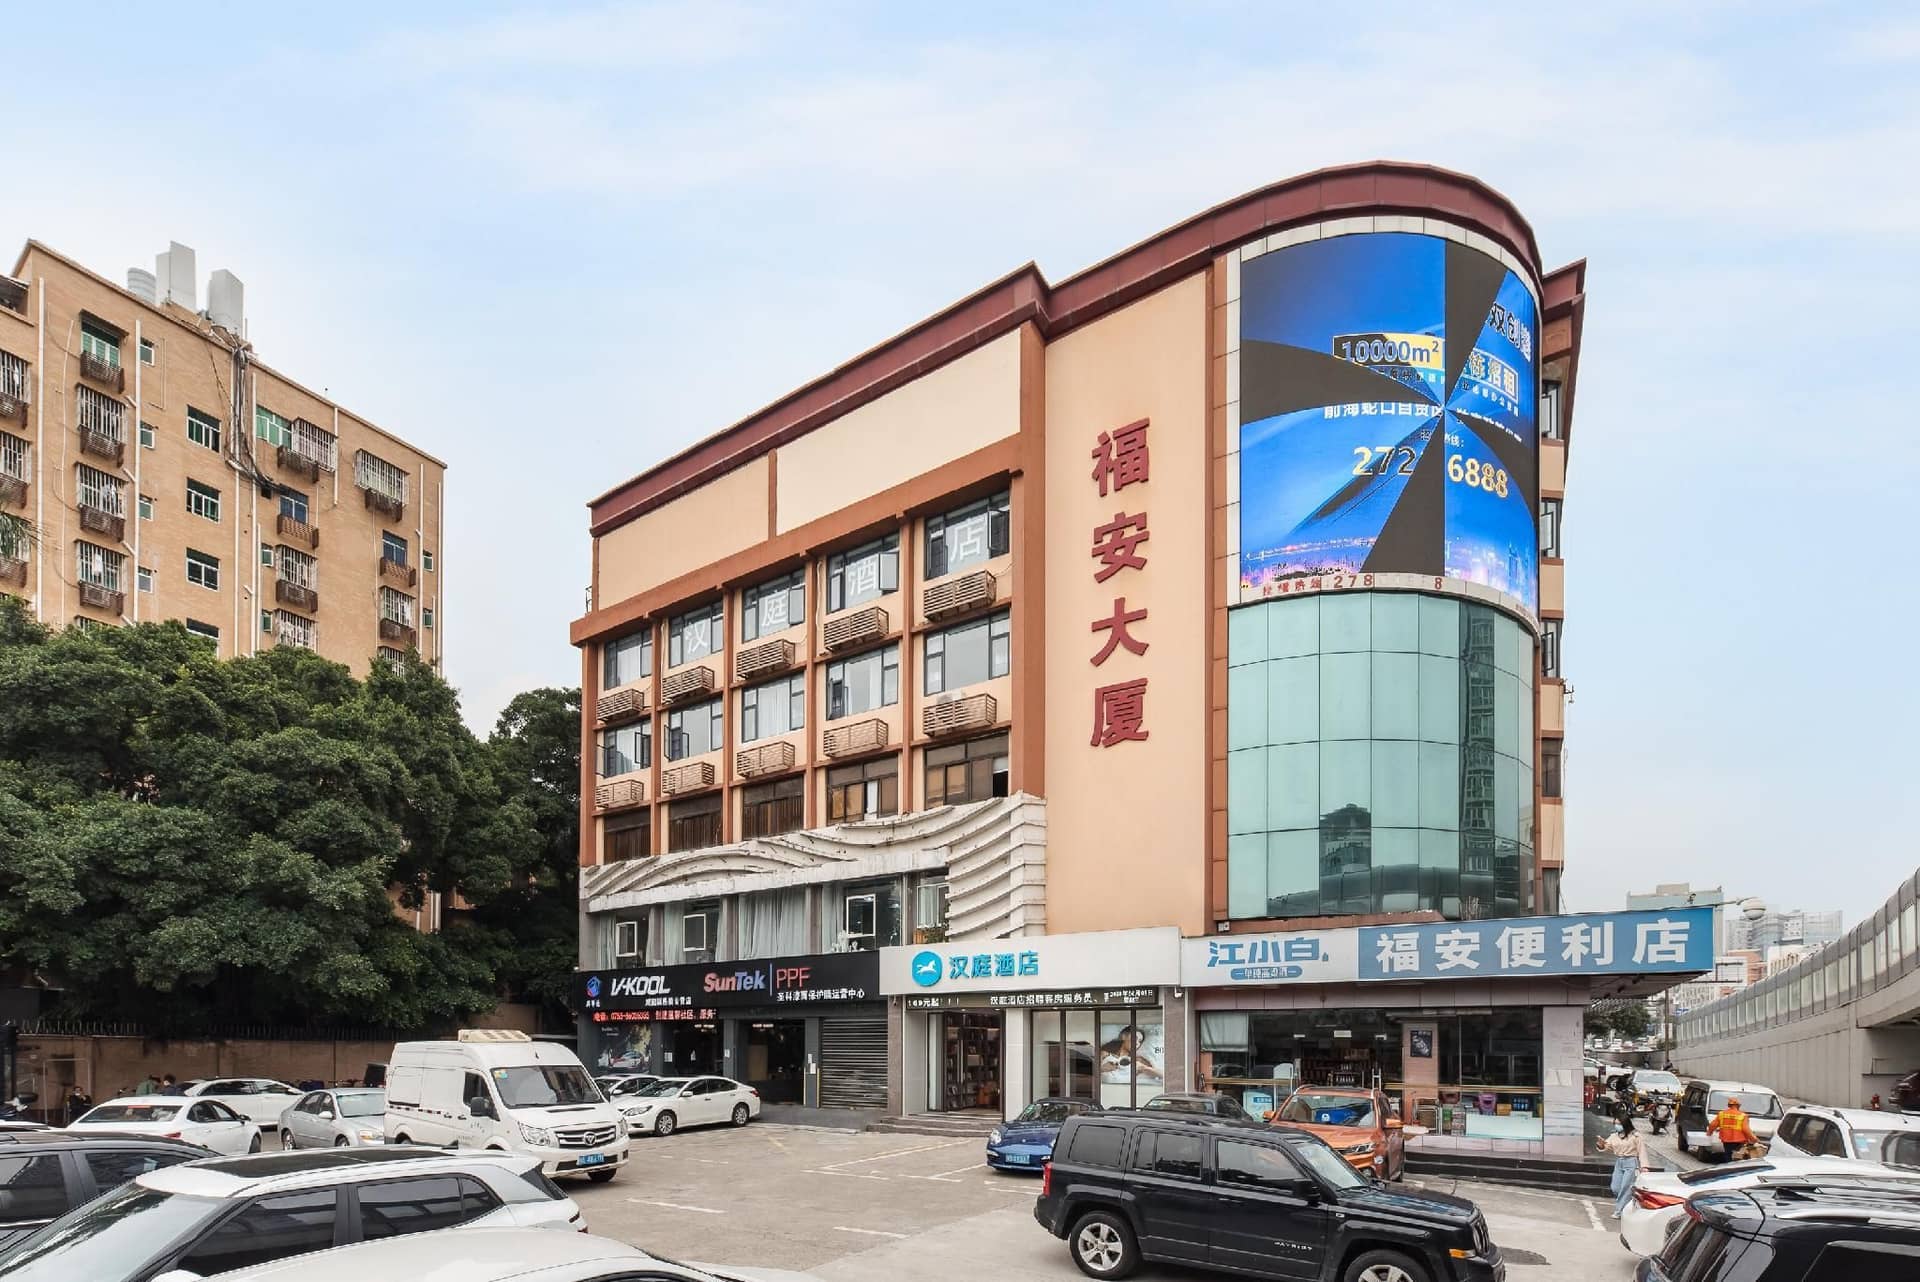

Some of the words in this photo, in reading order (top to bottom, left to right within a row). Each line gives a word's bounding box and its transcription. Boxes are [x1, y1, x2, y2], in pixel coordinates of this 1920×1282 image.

[1448, 454, 1508, 497] 6888
[1090, 417, 1150, 748] 福安大厦
[1208, 937, 1320, 968] 江小白
[1376, 919, 1690, 972] 福安便利店
[776, 967, 811, 989] PPF
[949, 950, 1039, 979] 汉庭酒店
[611, 975, 671, 996] V-KOOL
[703, 970, 766, 993] SunTek
